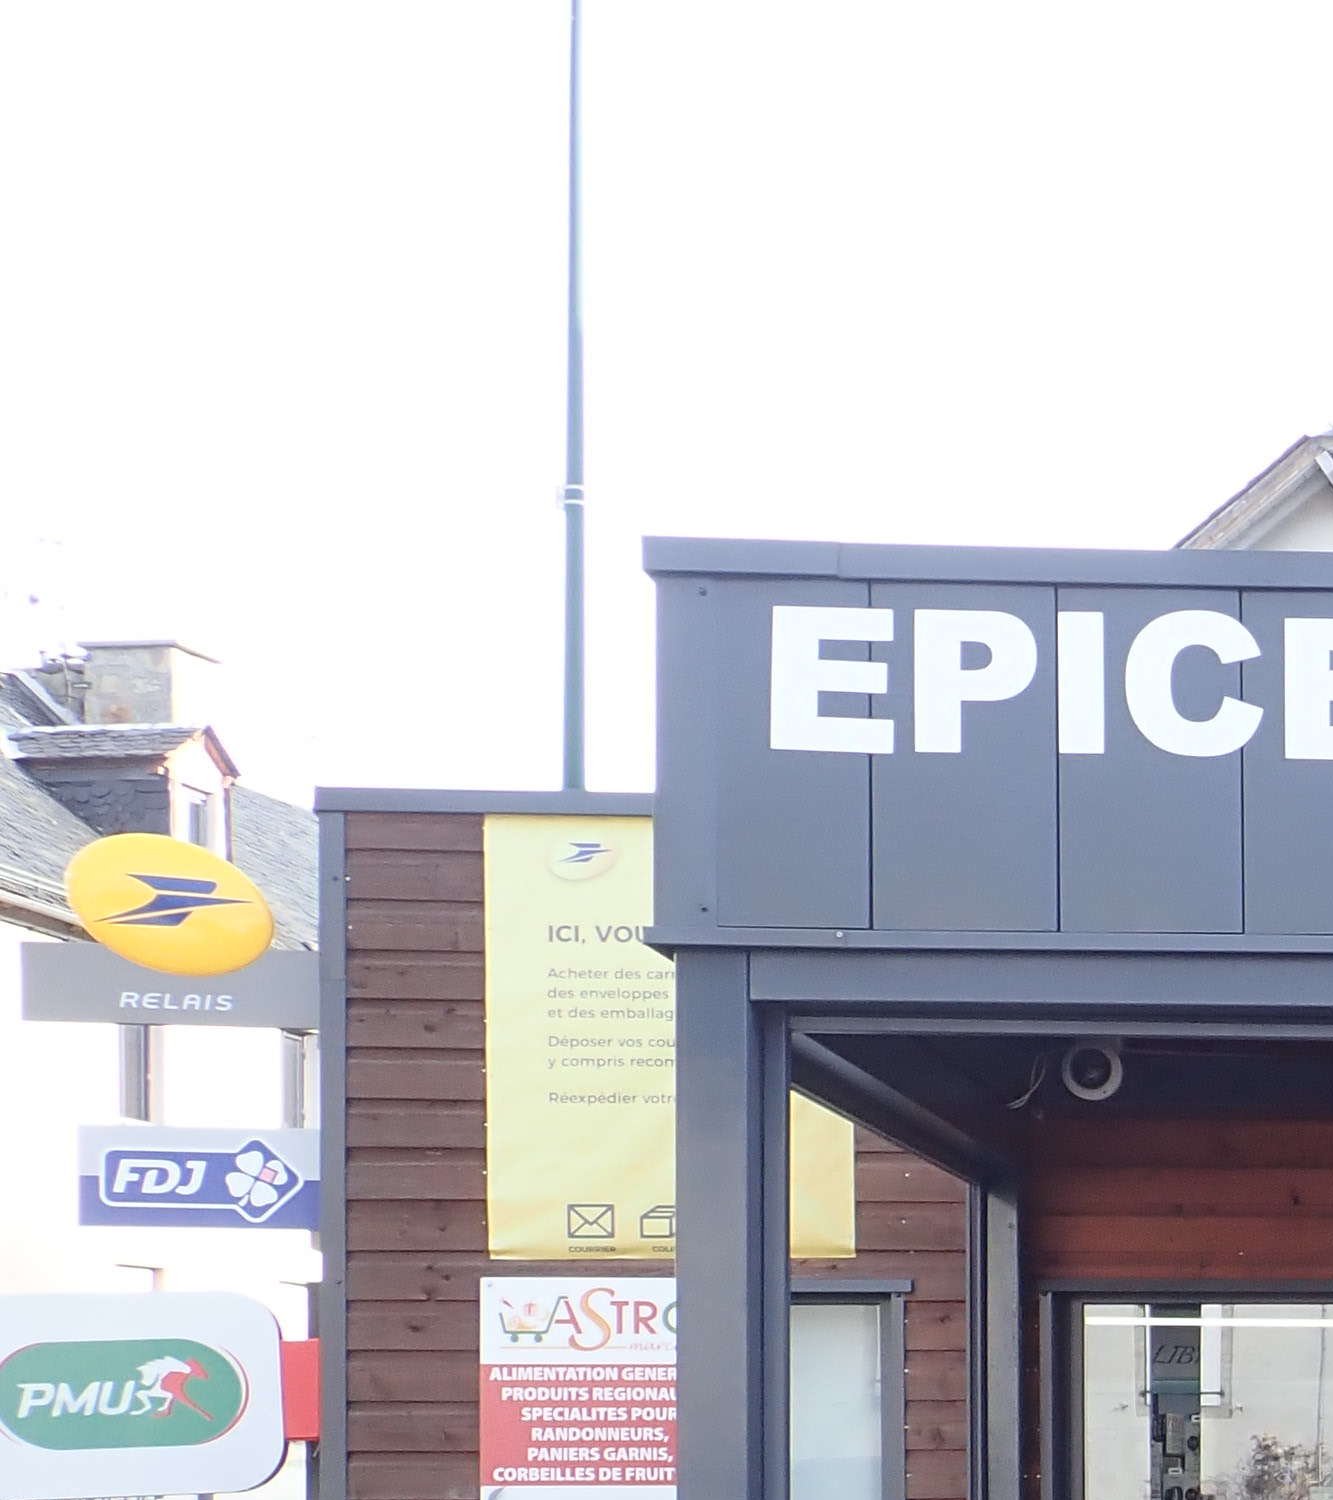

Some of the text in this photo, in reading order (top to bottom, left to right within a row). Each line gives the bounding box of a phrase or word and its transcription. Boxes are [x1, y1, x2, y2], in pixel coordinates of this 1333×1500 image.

[548, 924, 587, 944] ICI,
[547, 967, 609, 980] Acheter
[614, 967, 641, 980] des
[119, 991, 234, 1012] RELAIS
[547, 987, 669, 1002] des enveloppes
[547, 1008, 563, 1018] et
[568, 1007, 595, 1019] des
[548, 1035, 613, 1050] Déposer
[618, 1038, 643, 1047] vos
[547, 1058, 556, 1069] y
[561, 1056, 625, 1069] compris
[548, 1091, 637, 1106] Réexpédier
[112, 1158, 208, 1195] FDJ
[489, 1367, 618, 1382] ALIMENTATION
[17, 1381, 135, 1419] PMU
[501, 1386, 590, 1402] PRODUITS
[520, 1407, 677, 1422] SPECIALITES POUR
[530, 1427, 670, 1442] RANDONNEURS,
[527, 1447, 674, 1463] PANIERS GARNIS,
[492, 1467, 676, 1482] CORBEILLES DE FRUIT
